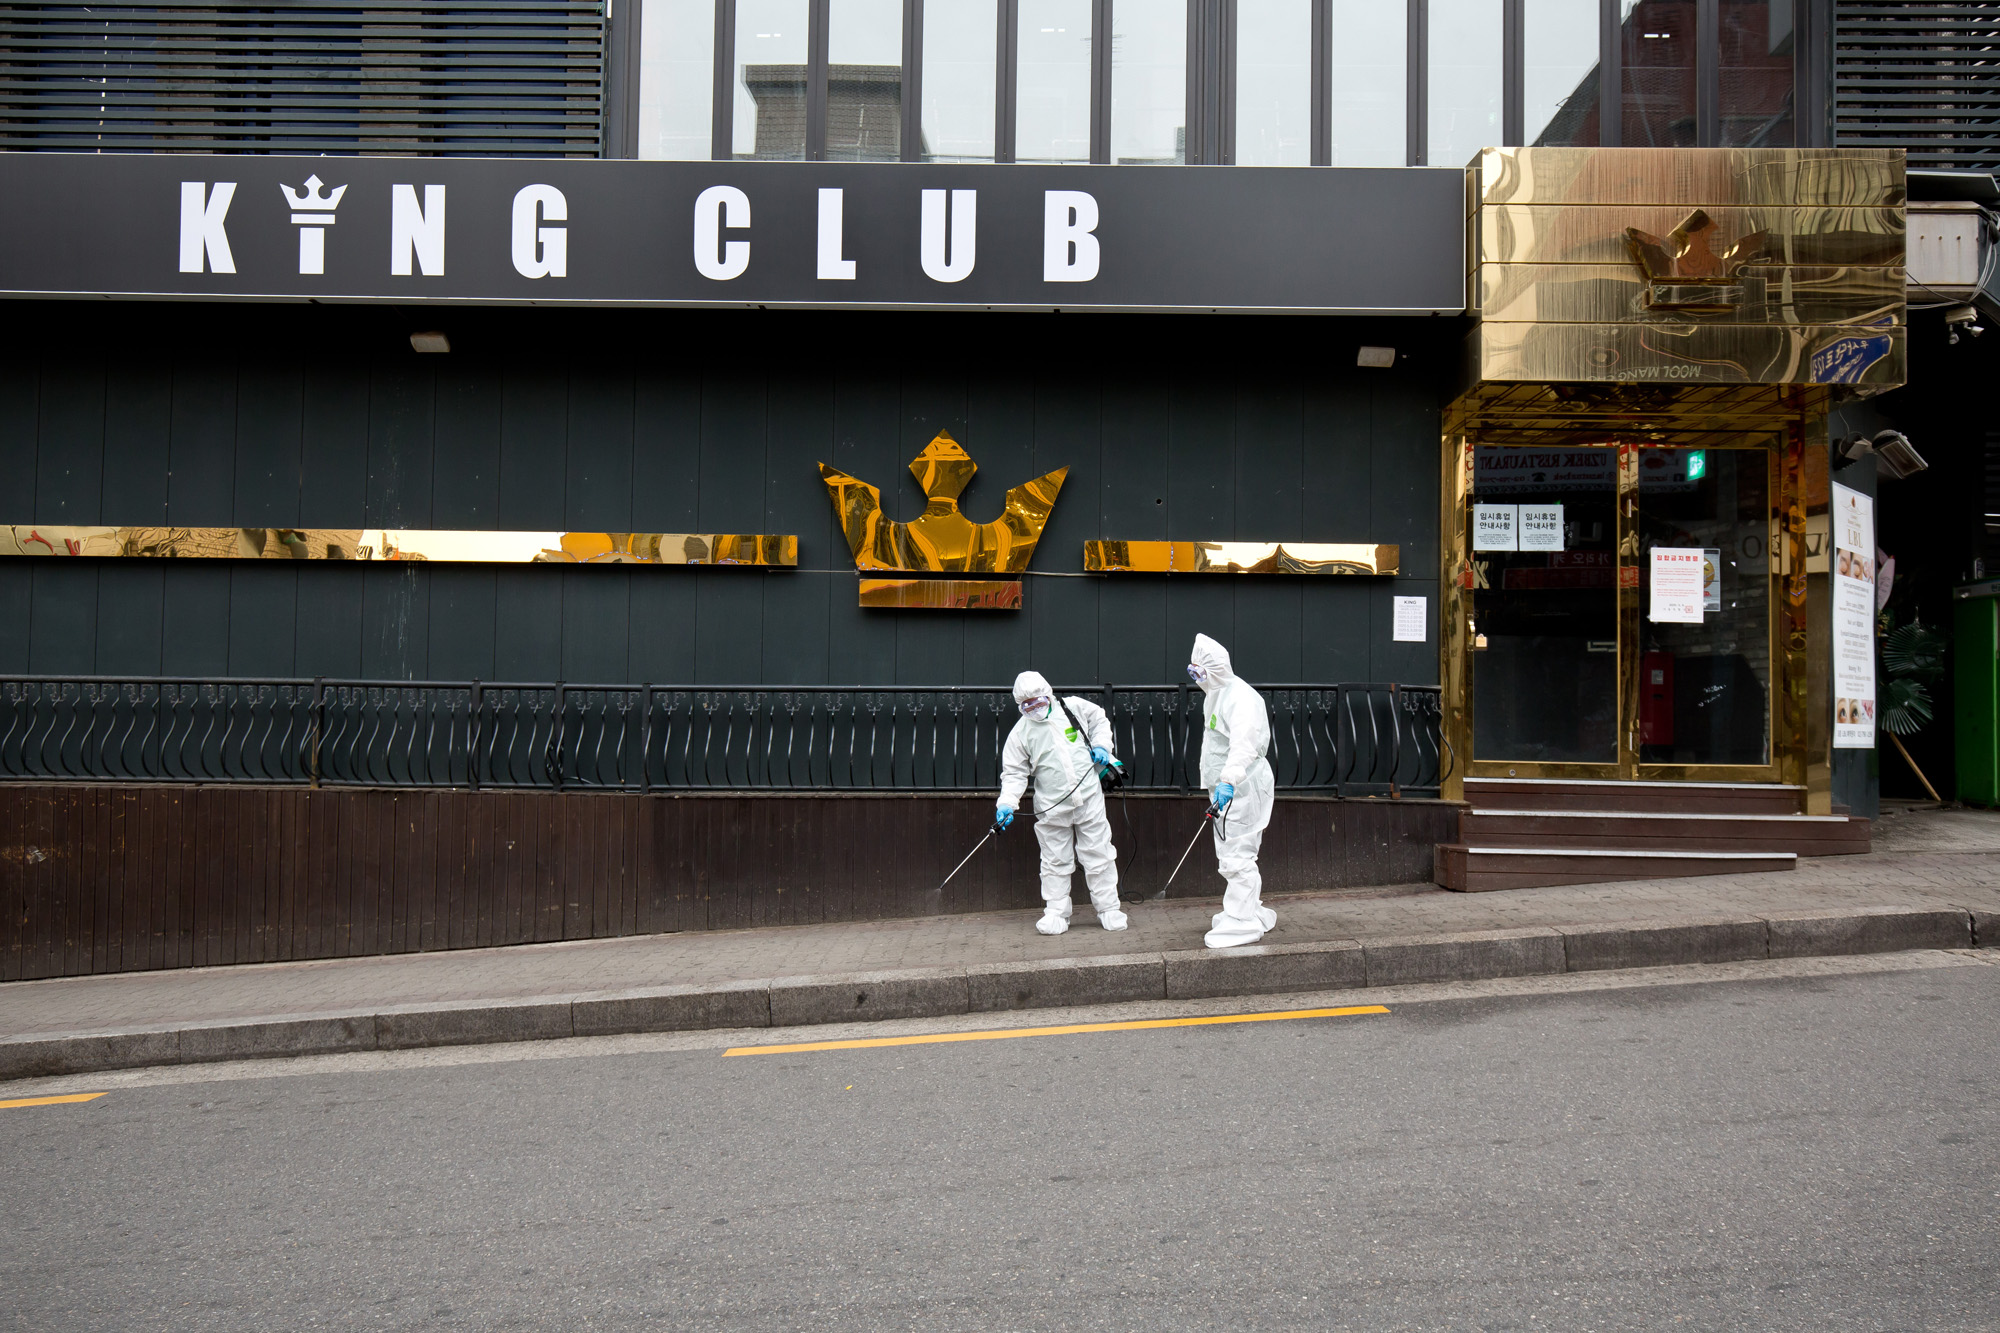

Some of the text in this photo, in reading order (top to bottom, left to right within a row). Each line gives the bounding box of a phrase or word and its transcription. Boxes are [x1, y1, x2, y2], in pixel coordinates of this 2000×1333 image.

[694, 185, 1101, 283] CLUB
[1479, 512, 1511, 521] 임시휴업
[1525, 512, 1557, 521] 임시휴업
[1479, 521, 1511, 530] 안내사항
[1525, 521, 1557, 530] 안내사항
[1848, 529, 1863, 548] LBL
